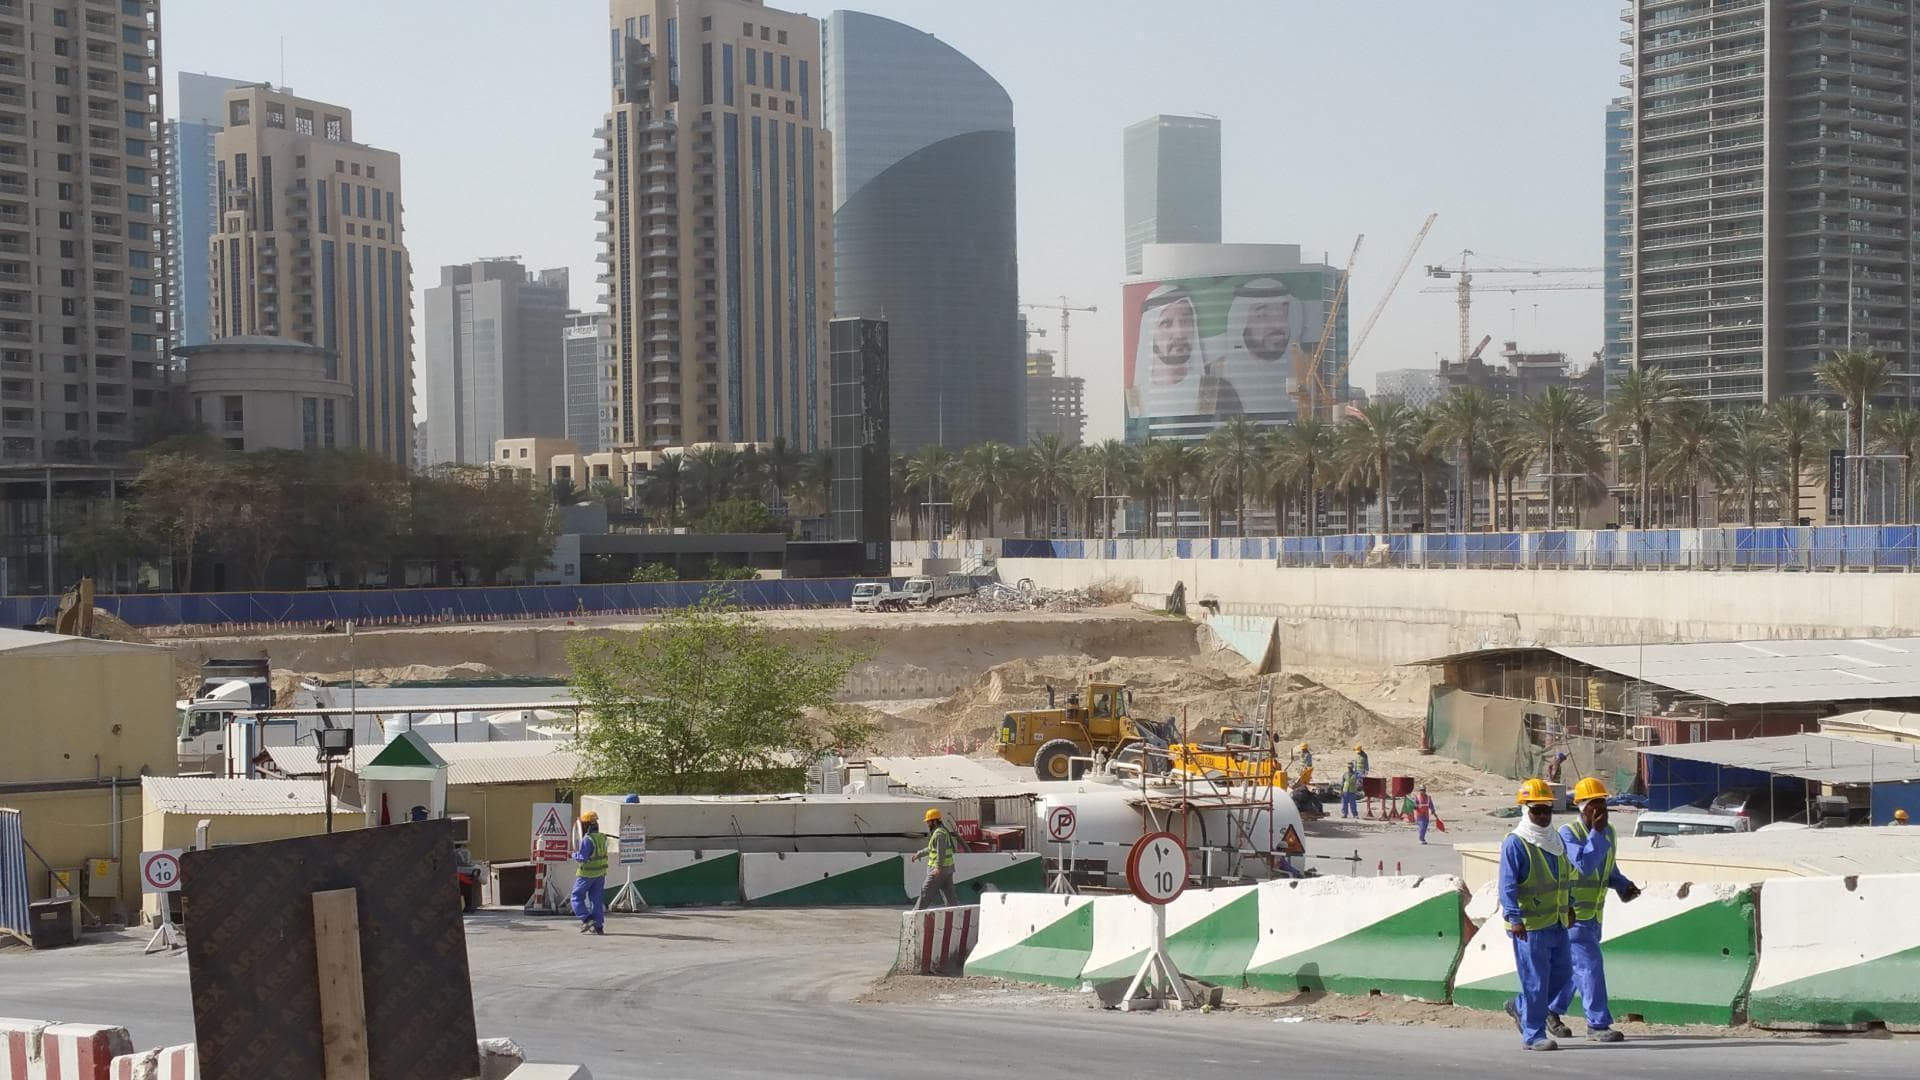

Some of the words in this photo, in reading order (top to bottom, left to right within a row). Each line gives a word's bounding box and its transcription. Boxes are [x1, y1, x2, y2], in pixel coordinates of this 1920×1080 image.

[1154, 842, 1170, 864] ١٠
[156, 861, 168, 869] ١٠
[155, 871, 172, 881] 10
[1154, 871, 1173, 893] 10
